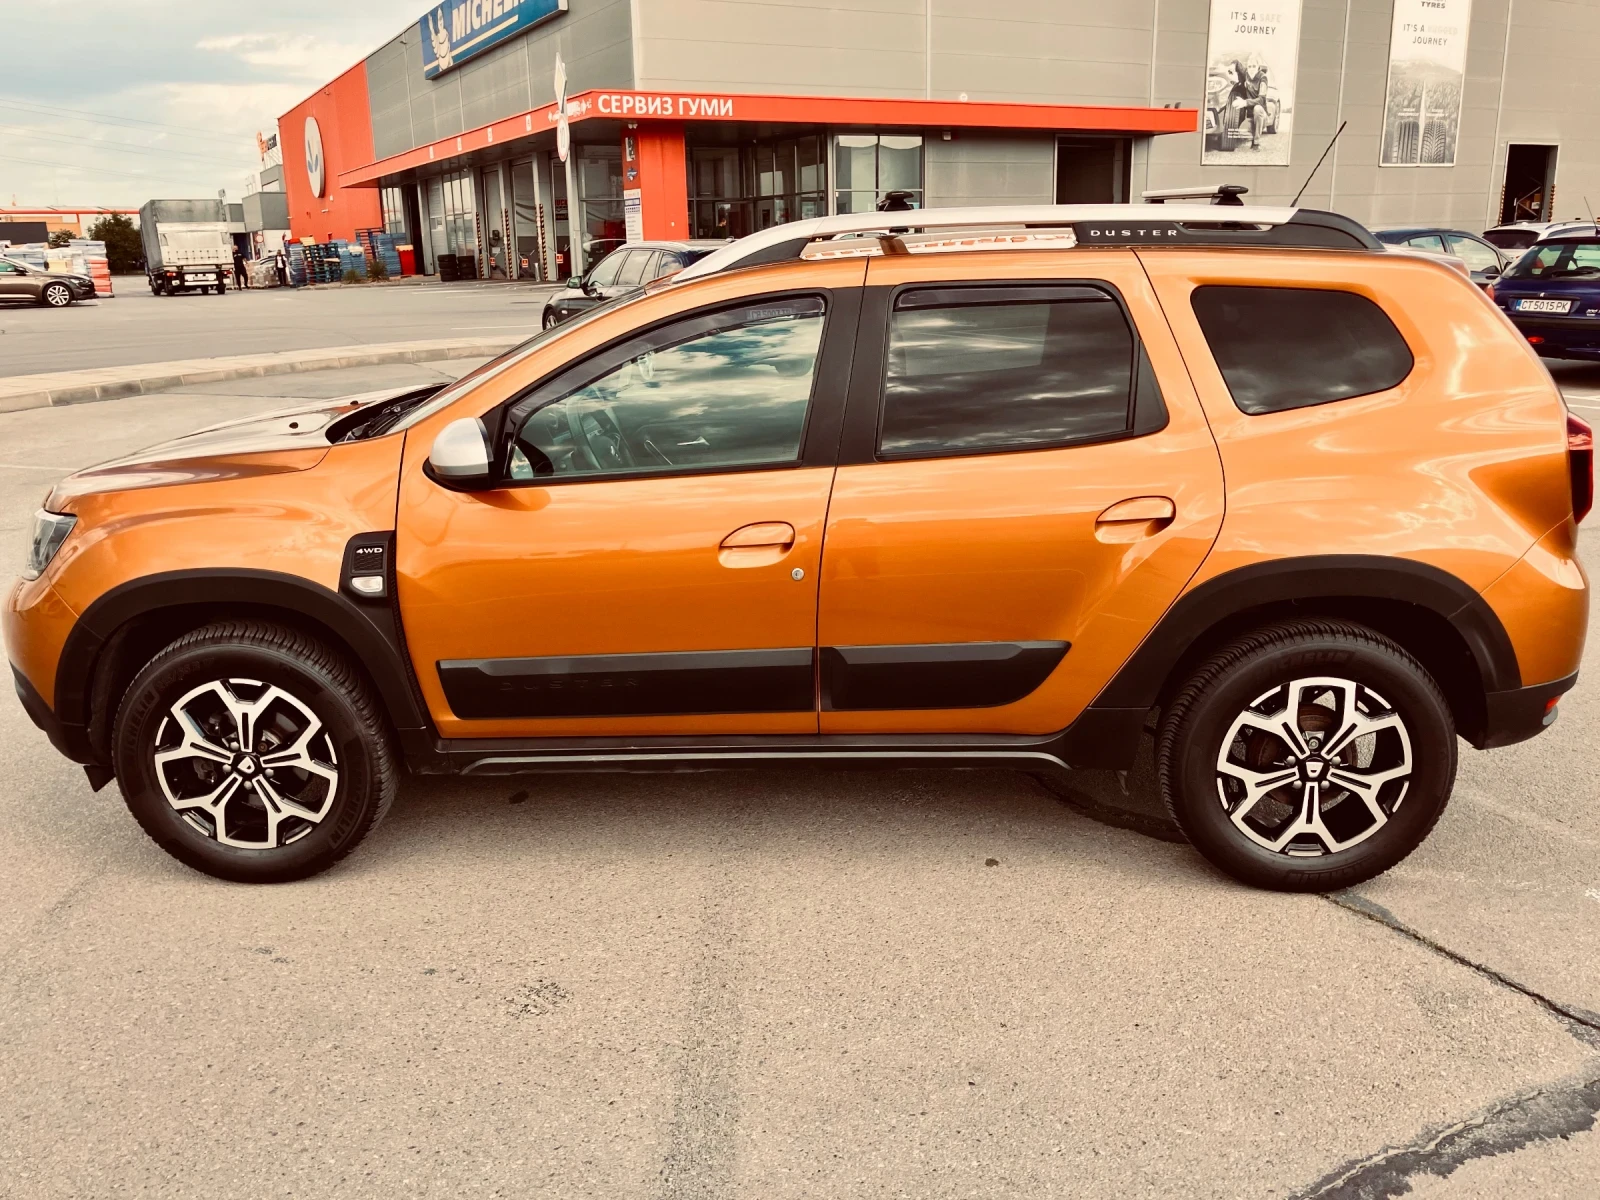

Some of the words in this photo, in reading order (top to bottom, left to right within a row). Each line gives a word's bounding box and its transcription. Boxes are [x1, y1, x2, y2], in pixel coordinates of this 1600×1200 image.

[1420, 1, 1446, 9] TYRES
[452, 0, 524, 43] MICHEL
[1230, 11, 1248, 21] IT'S
[1250, 12, 1257, 21] A
[1259, 13, 1282, 23] SAFE
[1234, 24, 1277, 35] JOURNEY
[1403, 23, 1418, 32] IT'S
[1419, 24, 1425, 33] A
[1412, 36, 1448, 46] JOURNEY
[597, 94, 674, 115] СЕРВИЗ
[678, 97, 734, 117] ГУМИ
[1090, 229, 1178, 237] DUSTER
